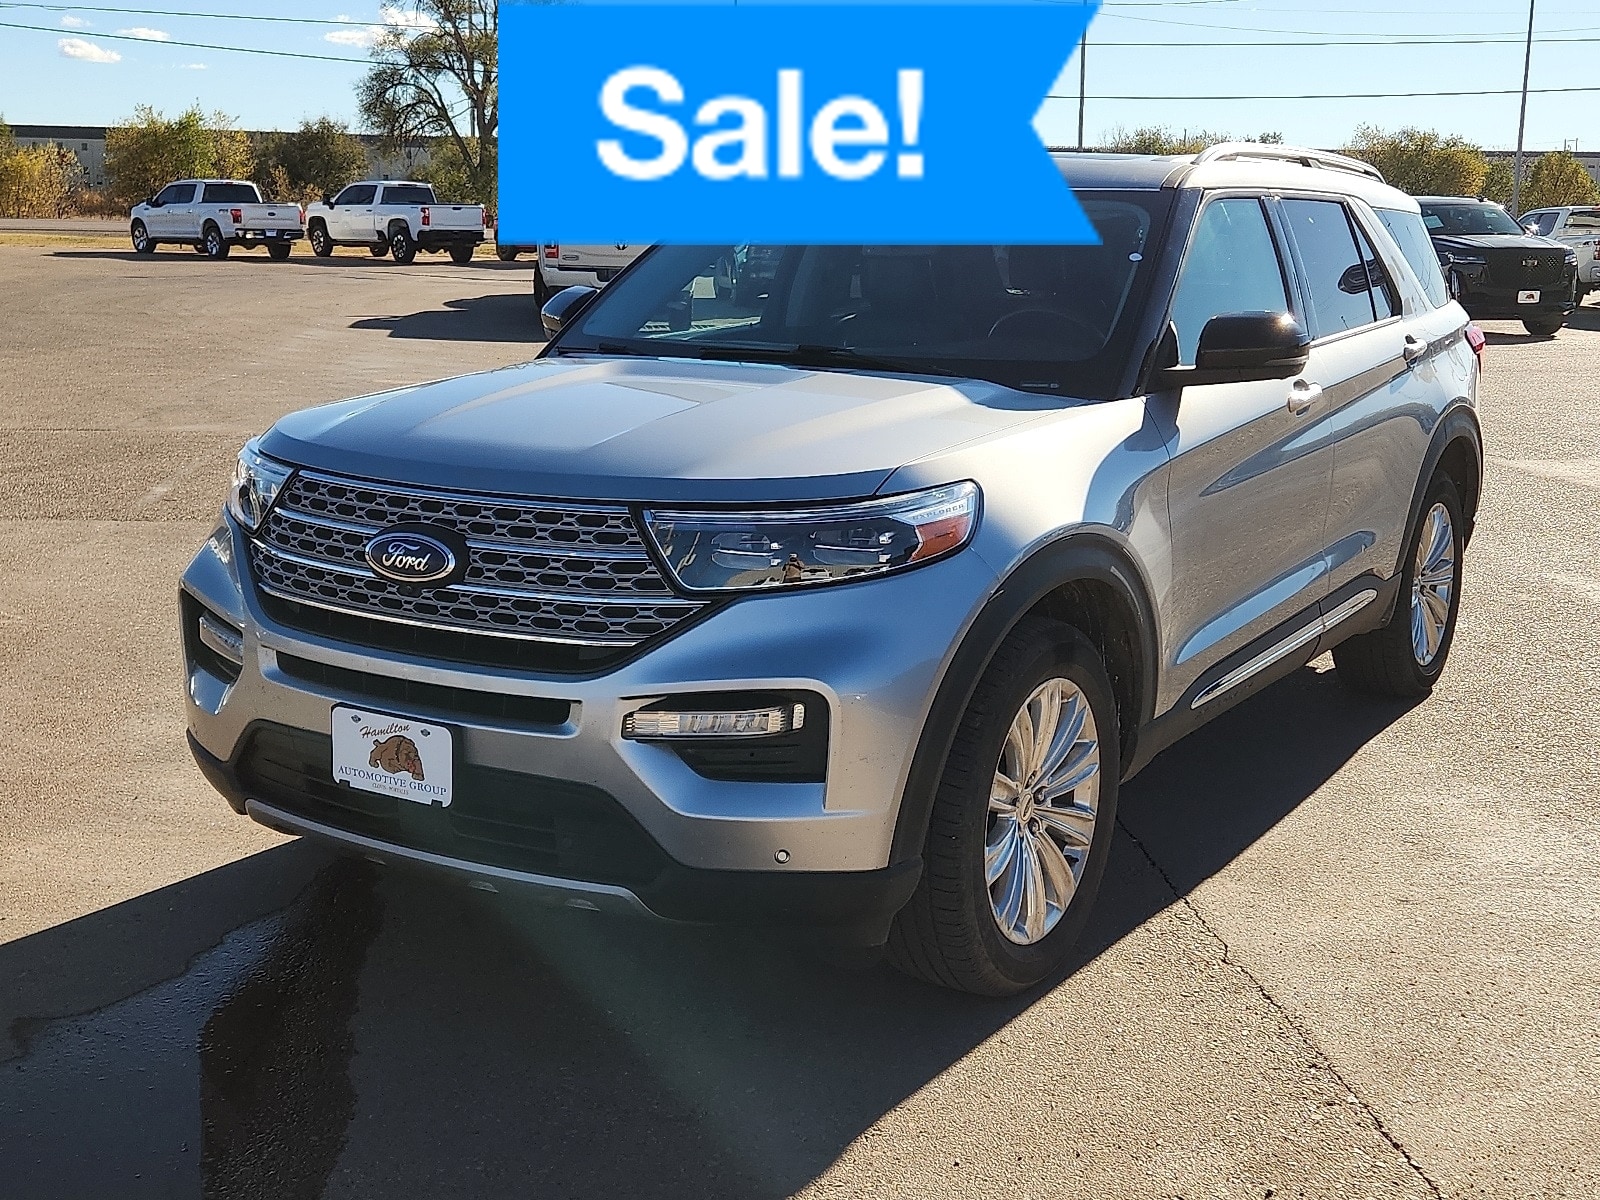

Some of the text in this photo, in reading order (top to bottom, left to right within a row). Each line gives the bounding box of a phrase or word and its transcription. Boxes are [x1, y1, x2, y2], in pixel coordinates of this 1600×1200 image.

[912, 504, 964, 520] EXPLORER
[382, 541, 431, 571] Ford
[360, 723, 410, 738] Hamilton
[338, 766, 407, 788] AUTOMOTIVE
[409, 781, 447, 796] GROUP
